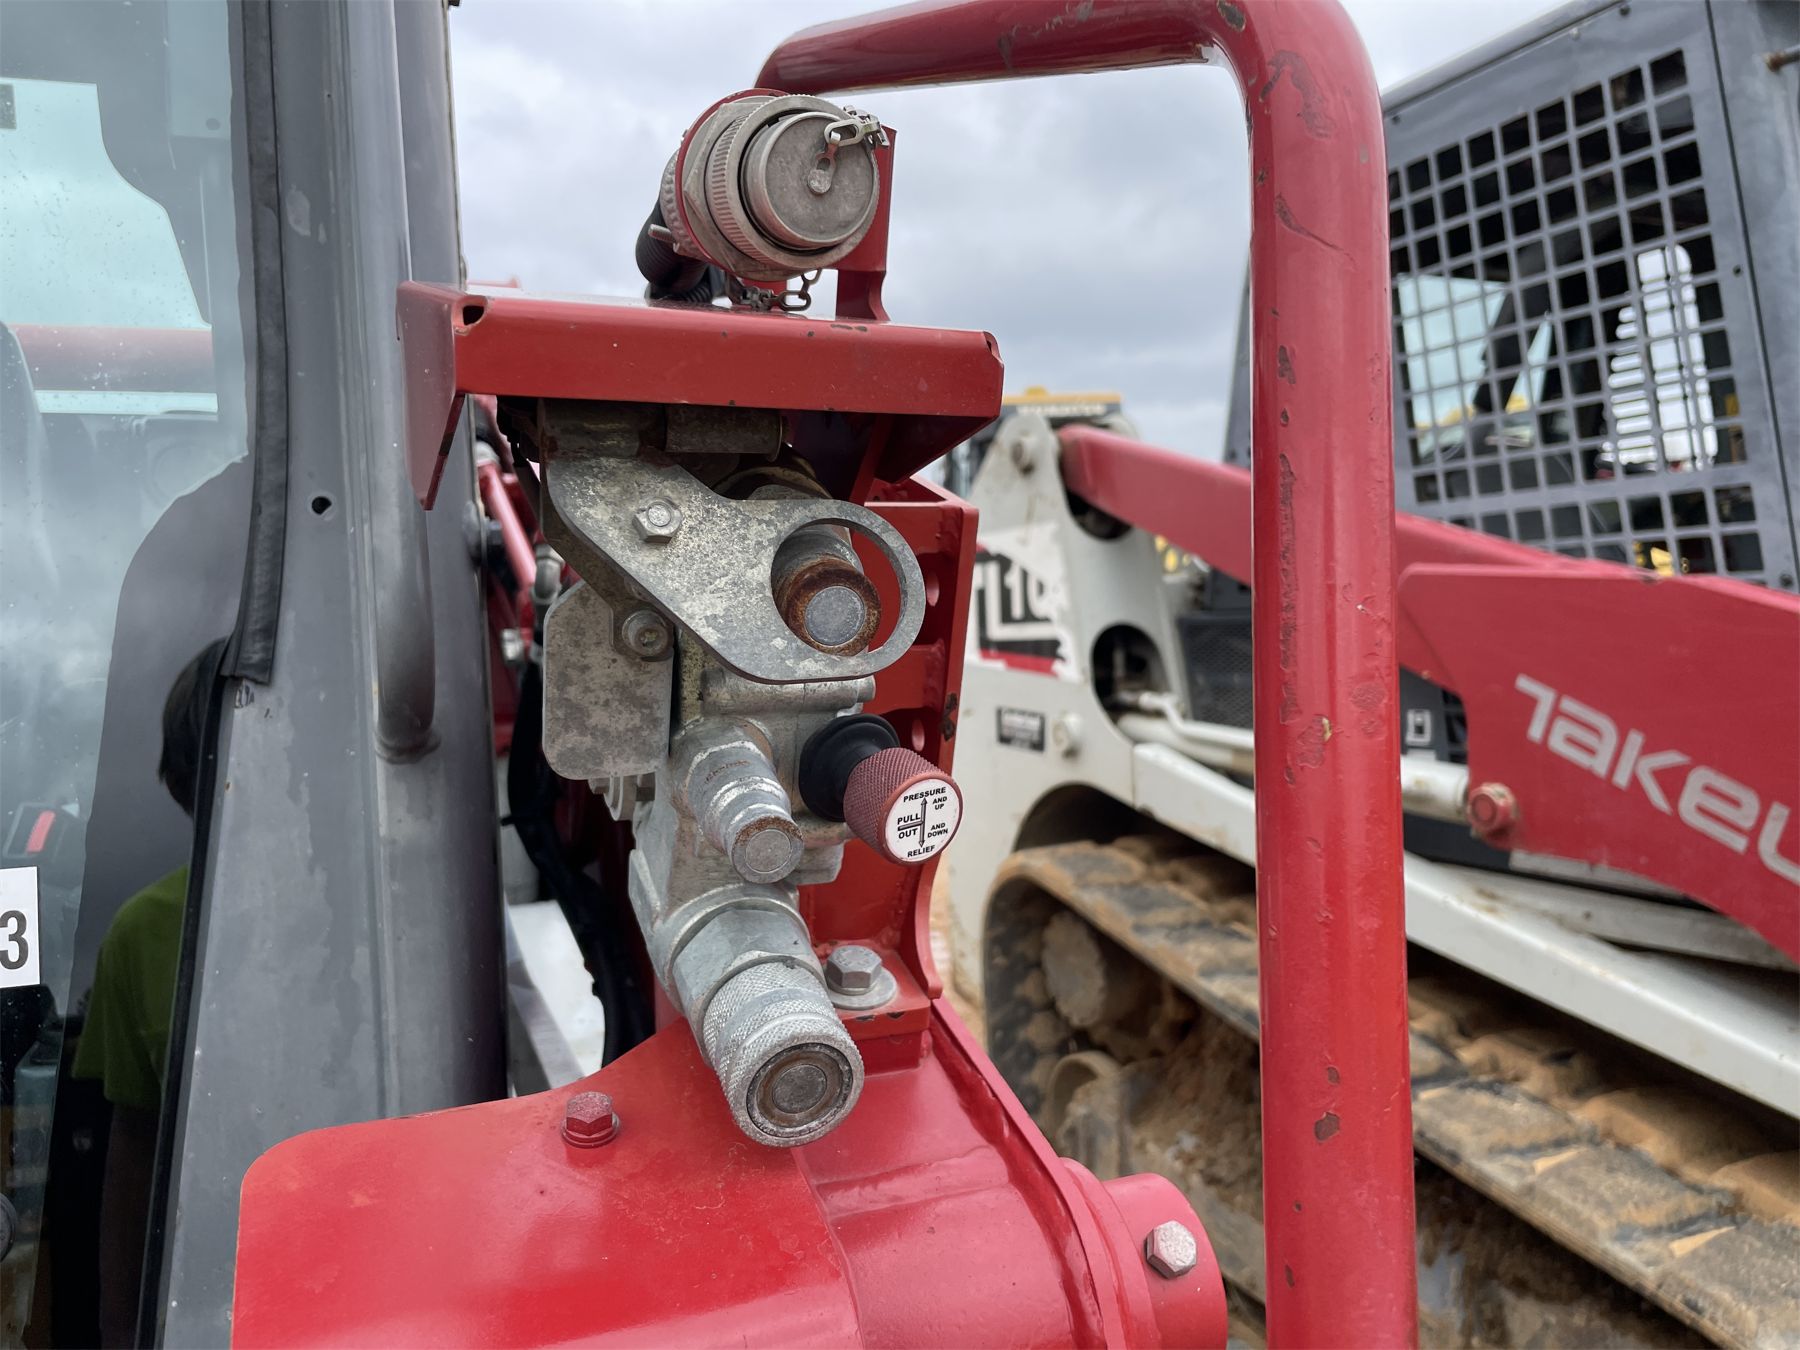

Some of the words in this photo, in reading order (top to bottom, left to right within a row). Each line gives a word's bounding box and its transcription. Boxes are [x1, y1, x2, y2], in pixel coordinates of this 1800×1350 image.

[903, 786, 946, 802] PRESSURE
[932, 796, 947, 804] AND
[897, 813, 920, 825] PULL
[930, 822, 945, 830] AND
[898, 828, 918, 839] OUT
[927, 828, 948, 838] DOWN
[907, 845, 935, 857] RELIEF
